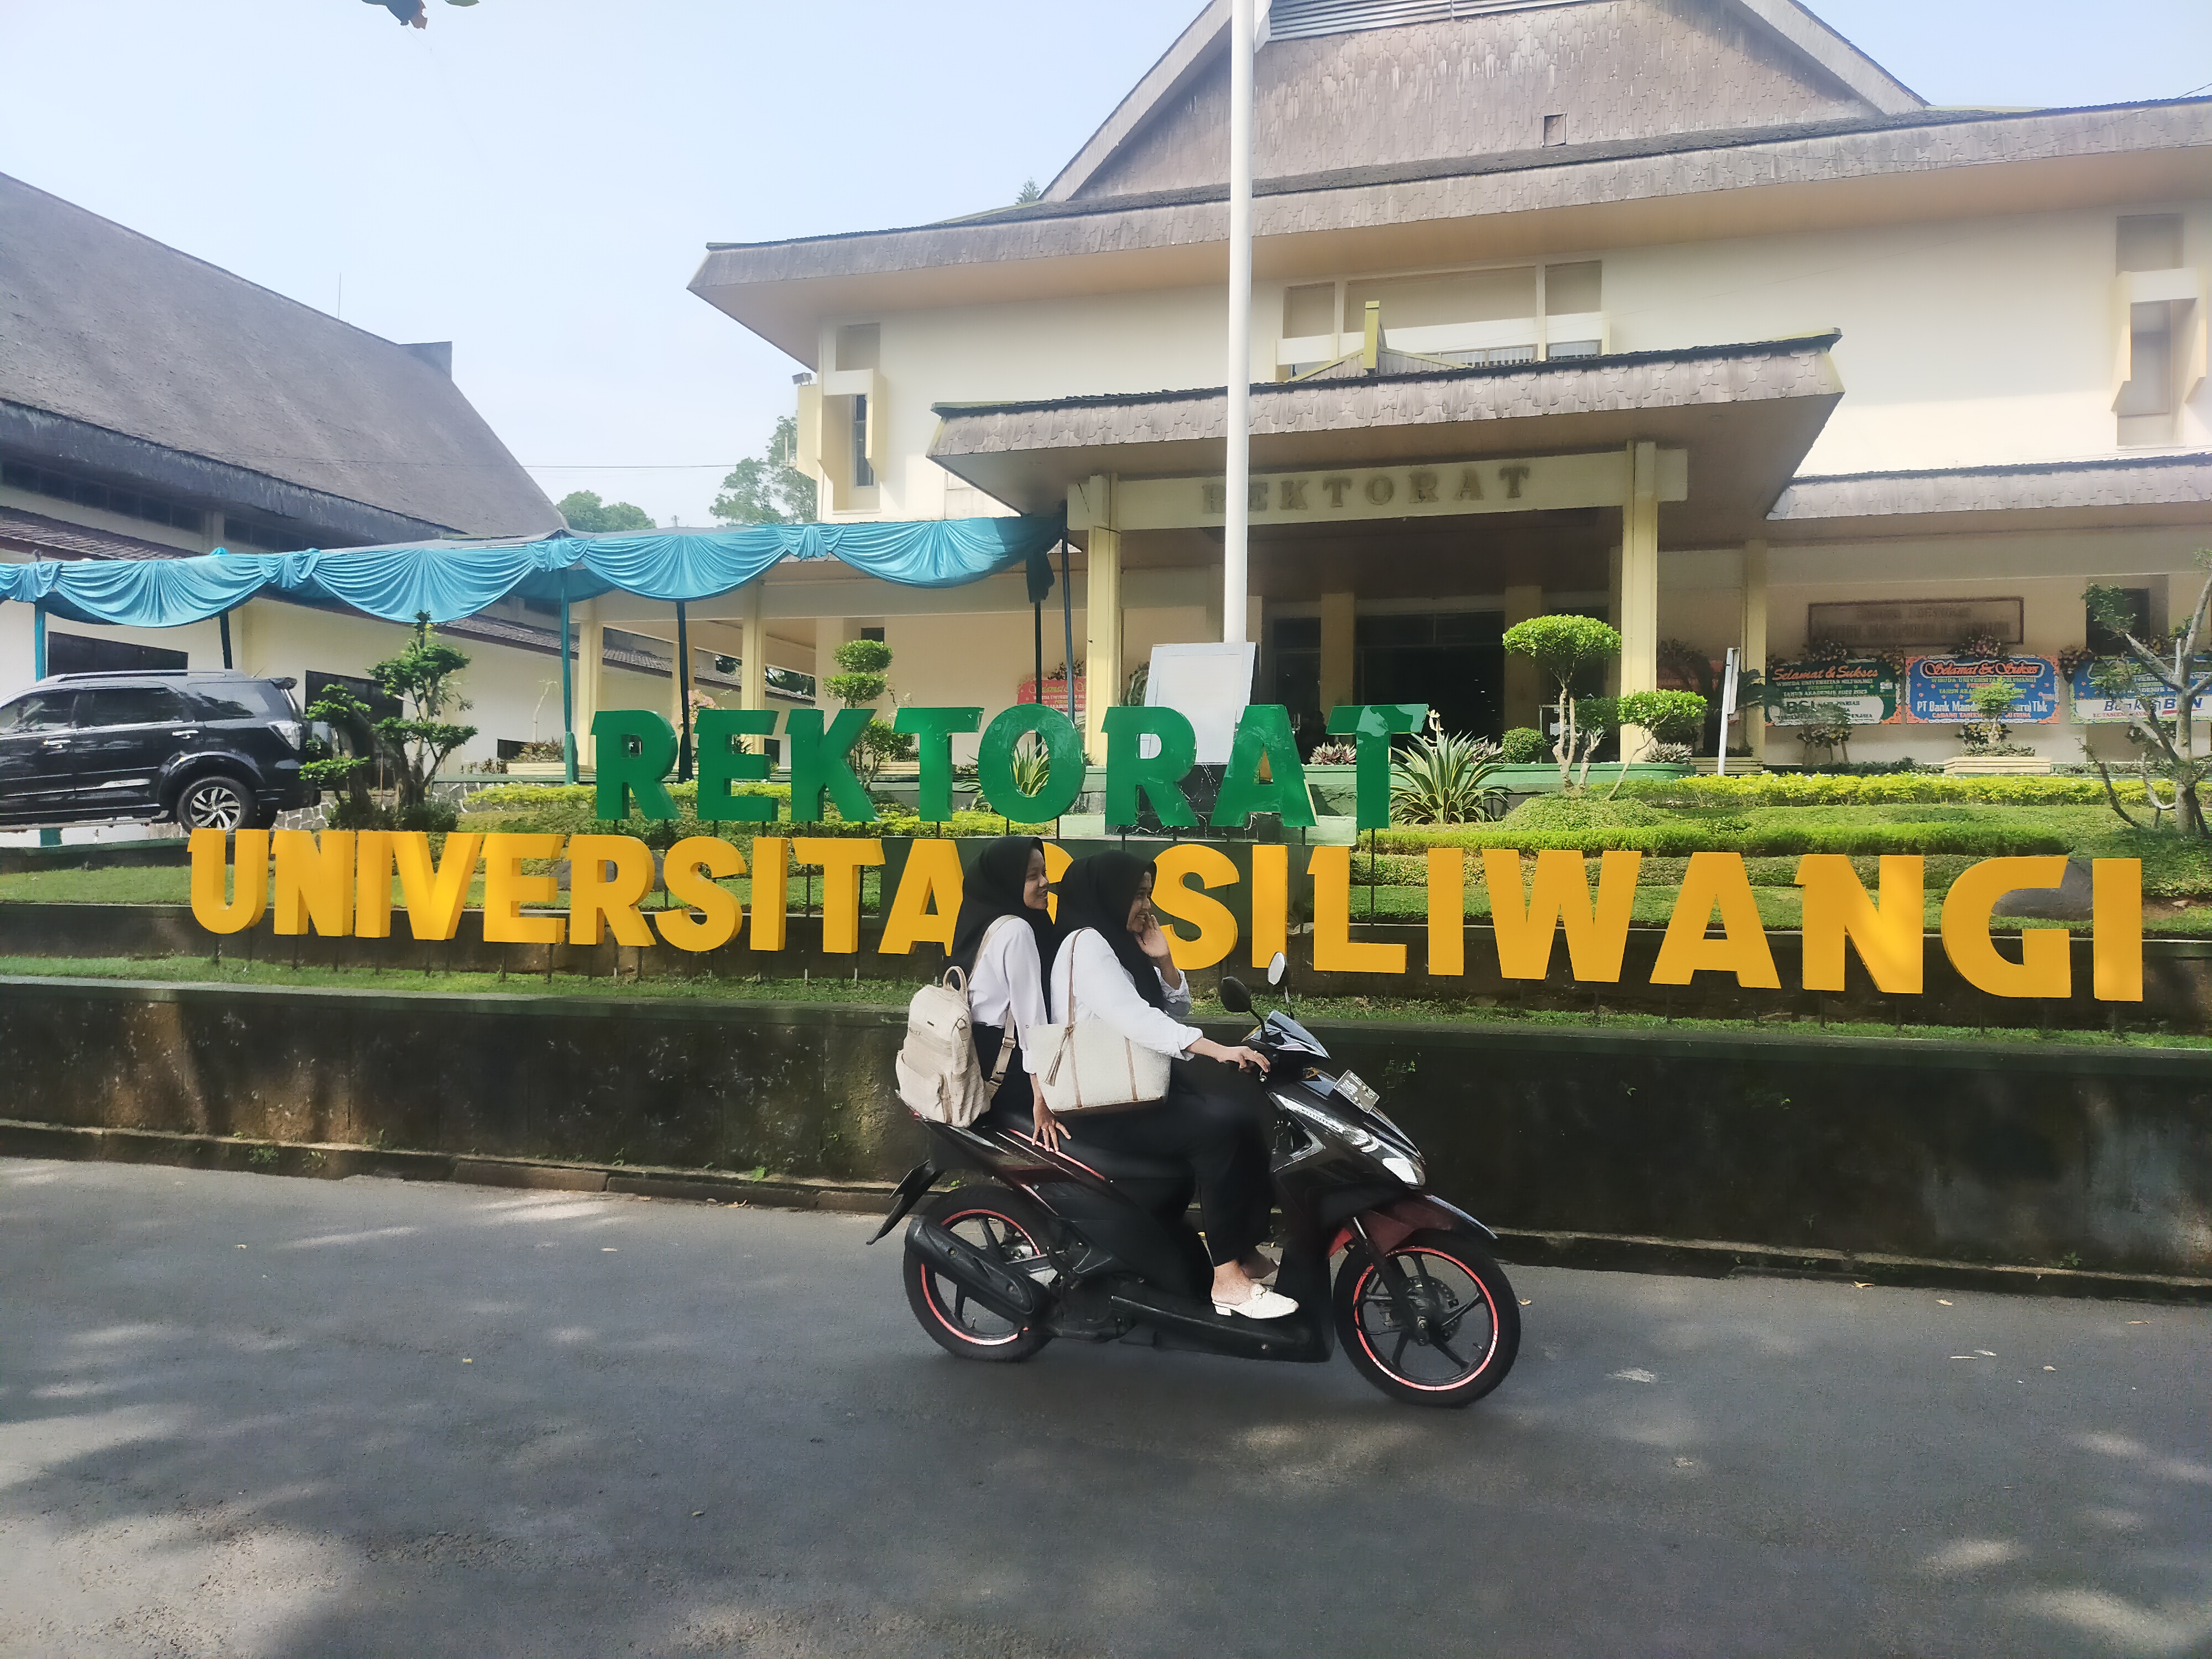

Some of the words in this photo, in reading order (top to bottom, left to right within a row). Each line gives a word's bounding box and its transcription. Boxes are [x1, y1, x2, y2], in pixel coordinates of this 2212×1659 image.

[1772, 668, 1824, 681] Selamat
[1825, 665, 1836, 679] &
[1836, 665, 1879, 679] Sukses
[1924, 663, 1978, 675] Selamat
[1995, 663, 2039, 675] Sukses
[1917, 701, 1927, 712] PT
[1929, 701, 1949, 712] Bank
[2032, 701, 2048, 712] Tbk
[2163, 697, 2203, 709] BN
[590, 703, 1429, 829] REKTORAT
[187, 828, 1073, 956] UNIVERSITA
[1151, 844, 2143, 1002] SILIWANGI
